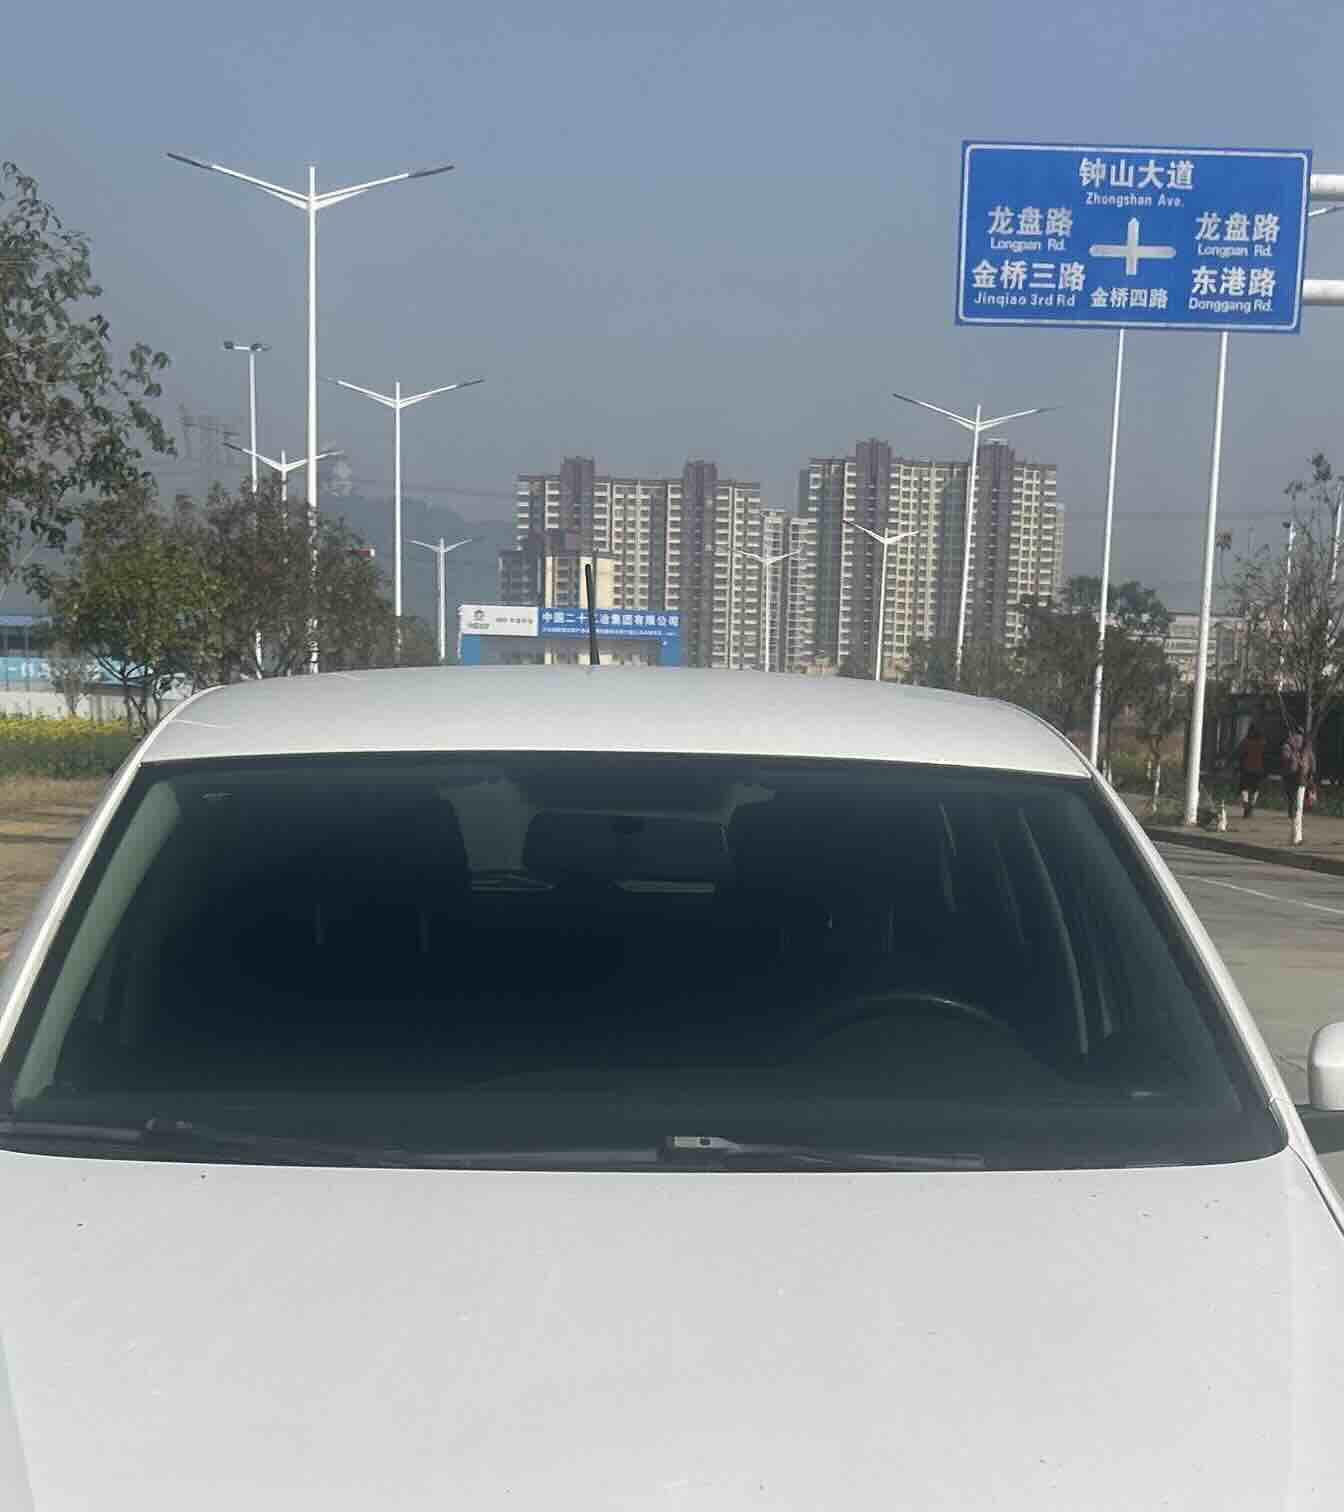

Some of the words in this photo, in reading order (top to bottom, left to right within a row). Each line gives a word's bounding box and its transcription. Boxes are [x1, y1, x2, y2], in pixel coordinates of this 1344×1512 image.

[1079, 157, 1195, 190] 钟山大道
[1086, 191, 1152, 207] Zhongshan
[1158, 193, 1184, 207] Ave.
[987, 205, 1073, 237] 龙盘路
[1195, 211, 1280, 243] 龙盘路
[990, 237, 1041, 253] Longpan
[1197, 244, 1248, 259] Longpan
[1254, 245, 1273, 257] Rd.
[972, 259, 1086, 291] 金桥三路
[1191, 265, 1276, 298] 东港路
[973, 291, 1027, 308] Jinqiao
[1030, 293, 1054, 307] 3rd
[1090, 287, 1169, 310] 金桥四路
[1188, 298, 1251, 314] Donggang
[542, 611, 679, 627] 中国二十冶集团有限公司
